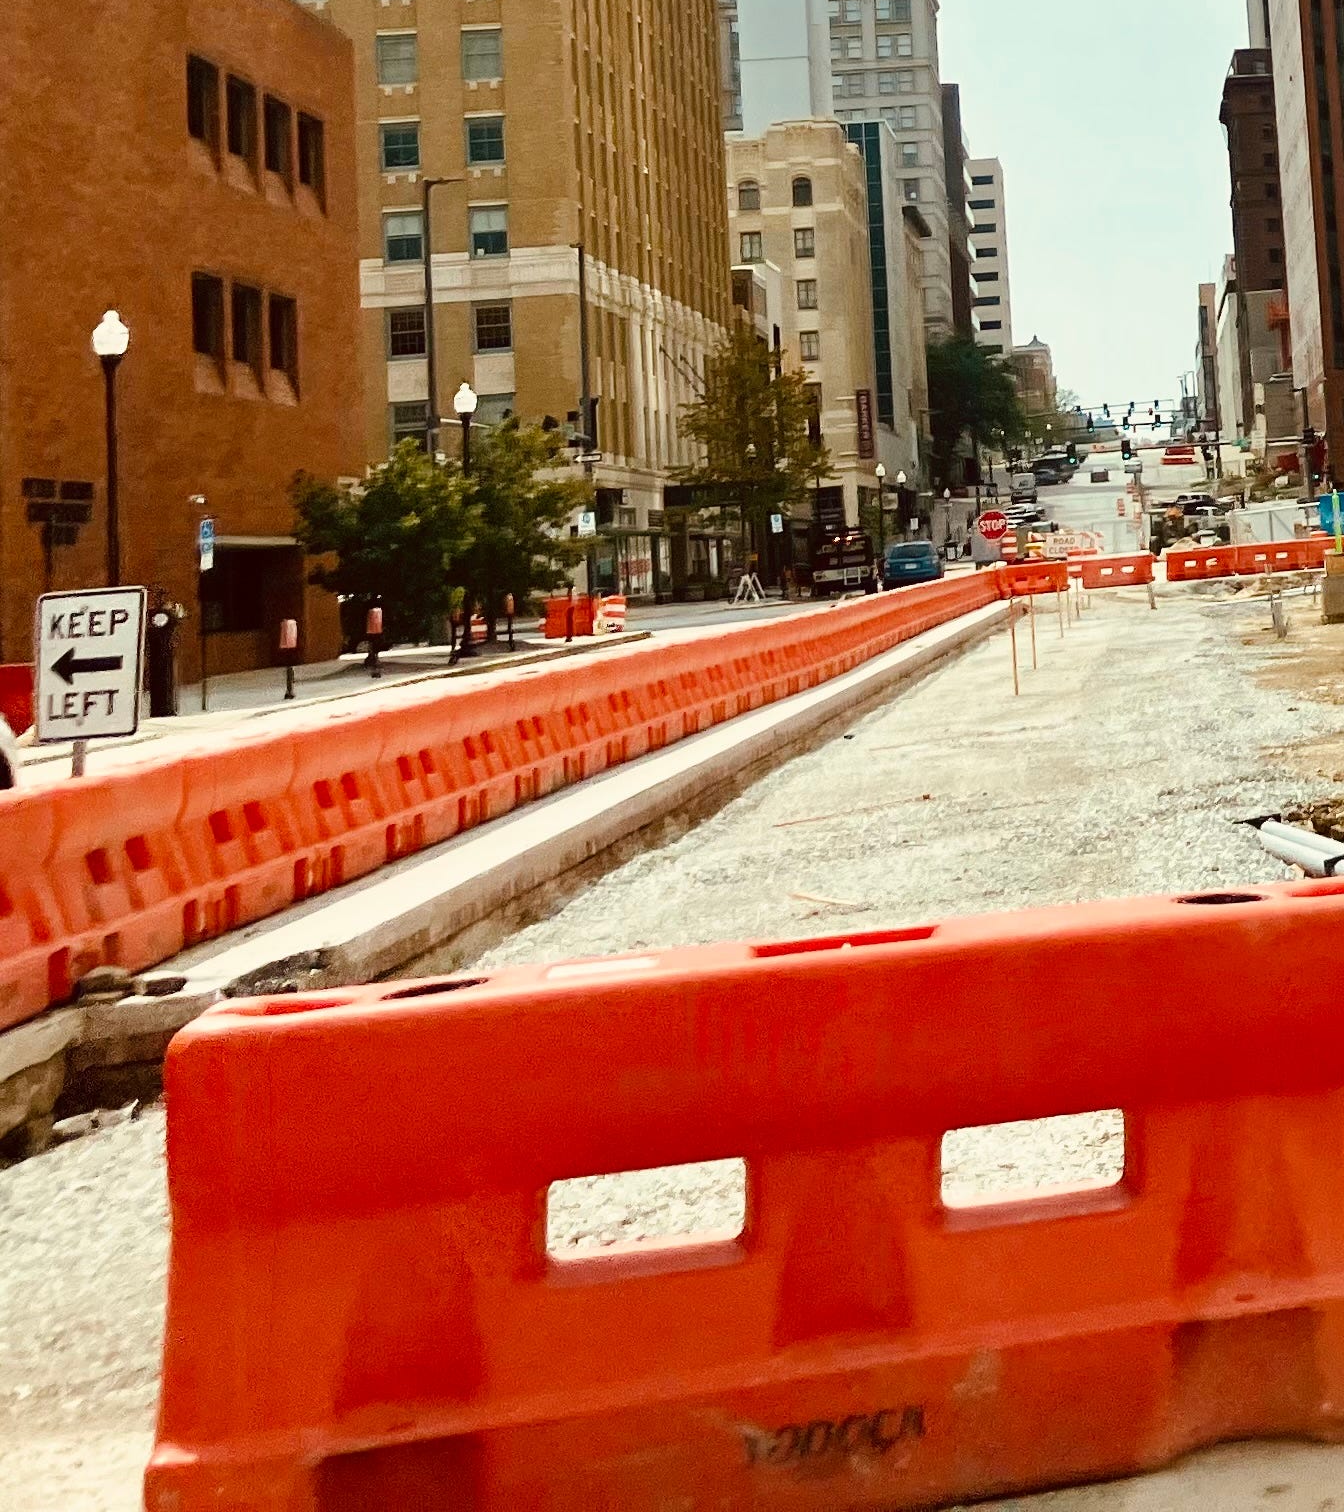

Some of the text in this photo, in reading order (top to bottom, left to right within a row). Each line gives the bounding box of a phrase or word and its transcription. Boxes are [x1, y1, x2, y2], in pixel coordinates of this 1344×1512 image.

[979, 518, 1006, 533] STOP
[1053, 536, 1076, 545] ROAD
[48, 608, 129, 639] KEEP
[48, 689, 120, 722] LEFT
